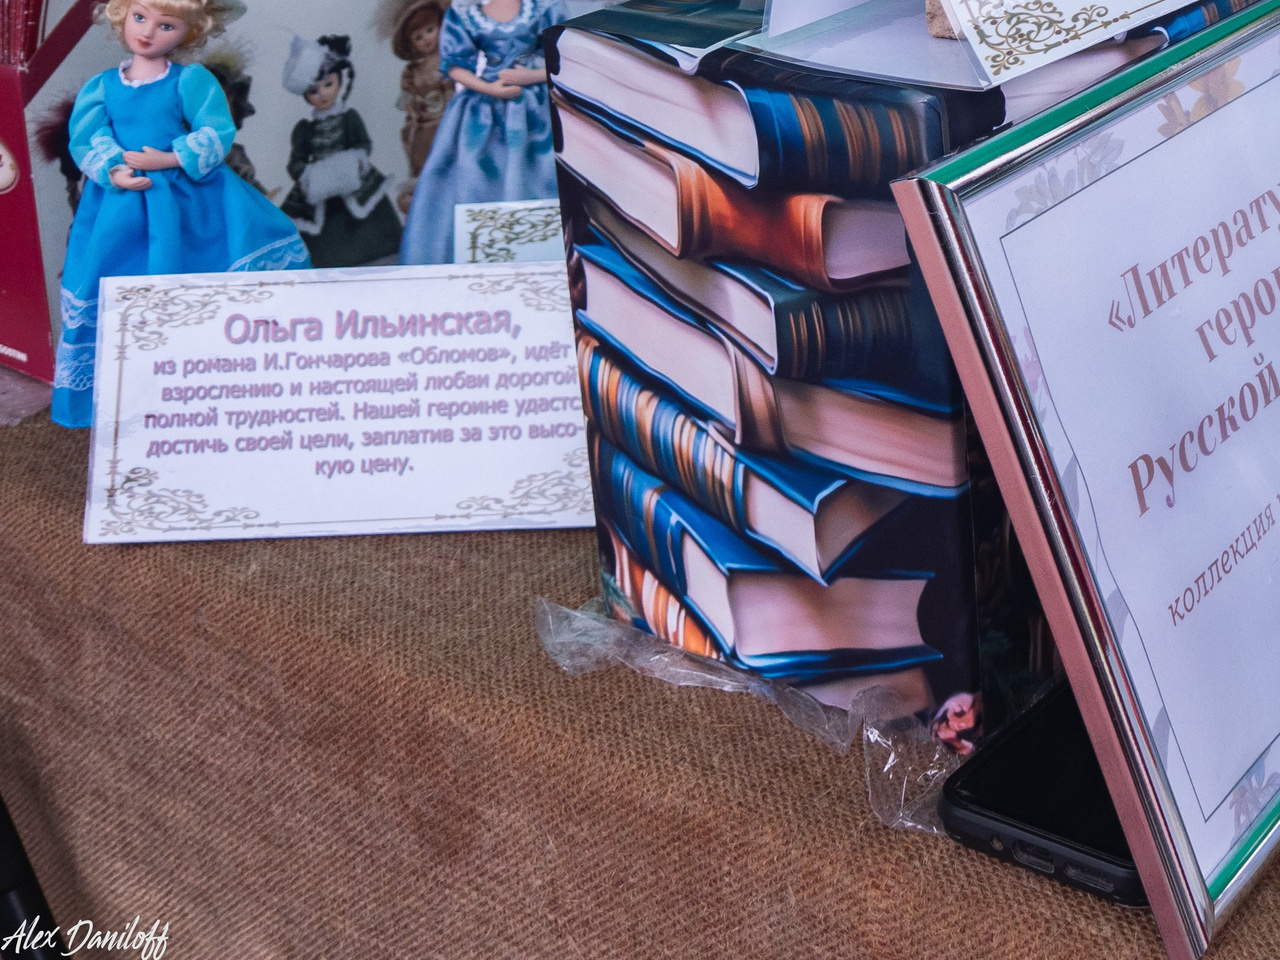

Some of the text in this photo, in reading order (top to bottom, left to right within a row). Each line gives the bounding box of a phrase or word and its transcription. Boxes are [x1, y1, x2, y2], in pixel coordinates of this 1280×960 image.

[223, 308, 521, 345] Ольга Ильинская,
[152, 340, 572, 379] из романа И.Гончарова «Обломов», идёт
[160, 364, 577, 405] взрослению и настоящей любви дорогой
[142, 395, 582, 430] полной трудностей. Нашей героине удастс
[145, 421, 585, 459] достичь своей цели, заплатив за это высо-
[314, 456, 414, 479] кую цену.
[1167, 502, 1276, 627] коллекция
